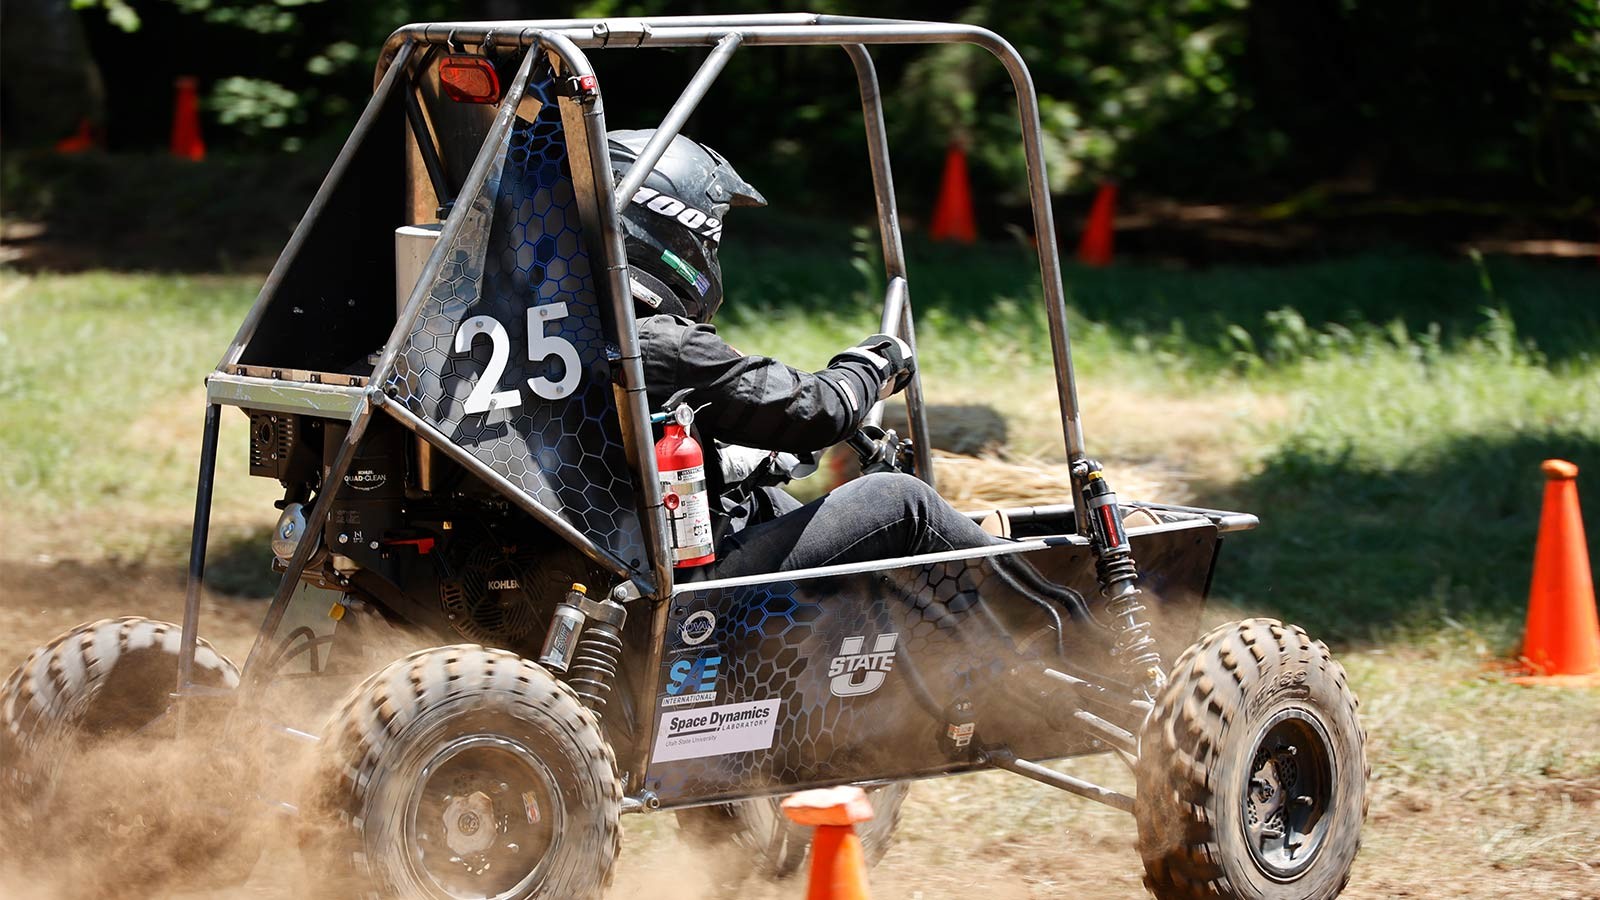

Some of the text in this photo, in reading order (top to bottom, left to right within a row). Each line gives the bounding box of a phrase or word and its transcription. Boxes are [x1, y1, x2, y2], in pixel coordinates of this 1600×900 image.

[632, 186, 722, 242] 100%
[455, 301, 582, 414] 25
[344, 474, 386, 482] QUAD-CLEAN
[666, 656, 722, 695] SAE
[828, 651, 896, 678] STATE
[669, 706, 770, 732] Space Dynamics
[722, 720, 768, 731] LABORATORY
[692, 735, 717, 744] University
